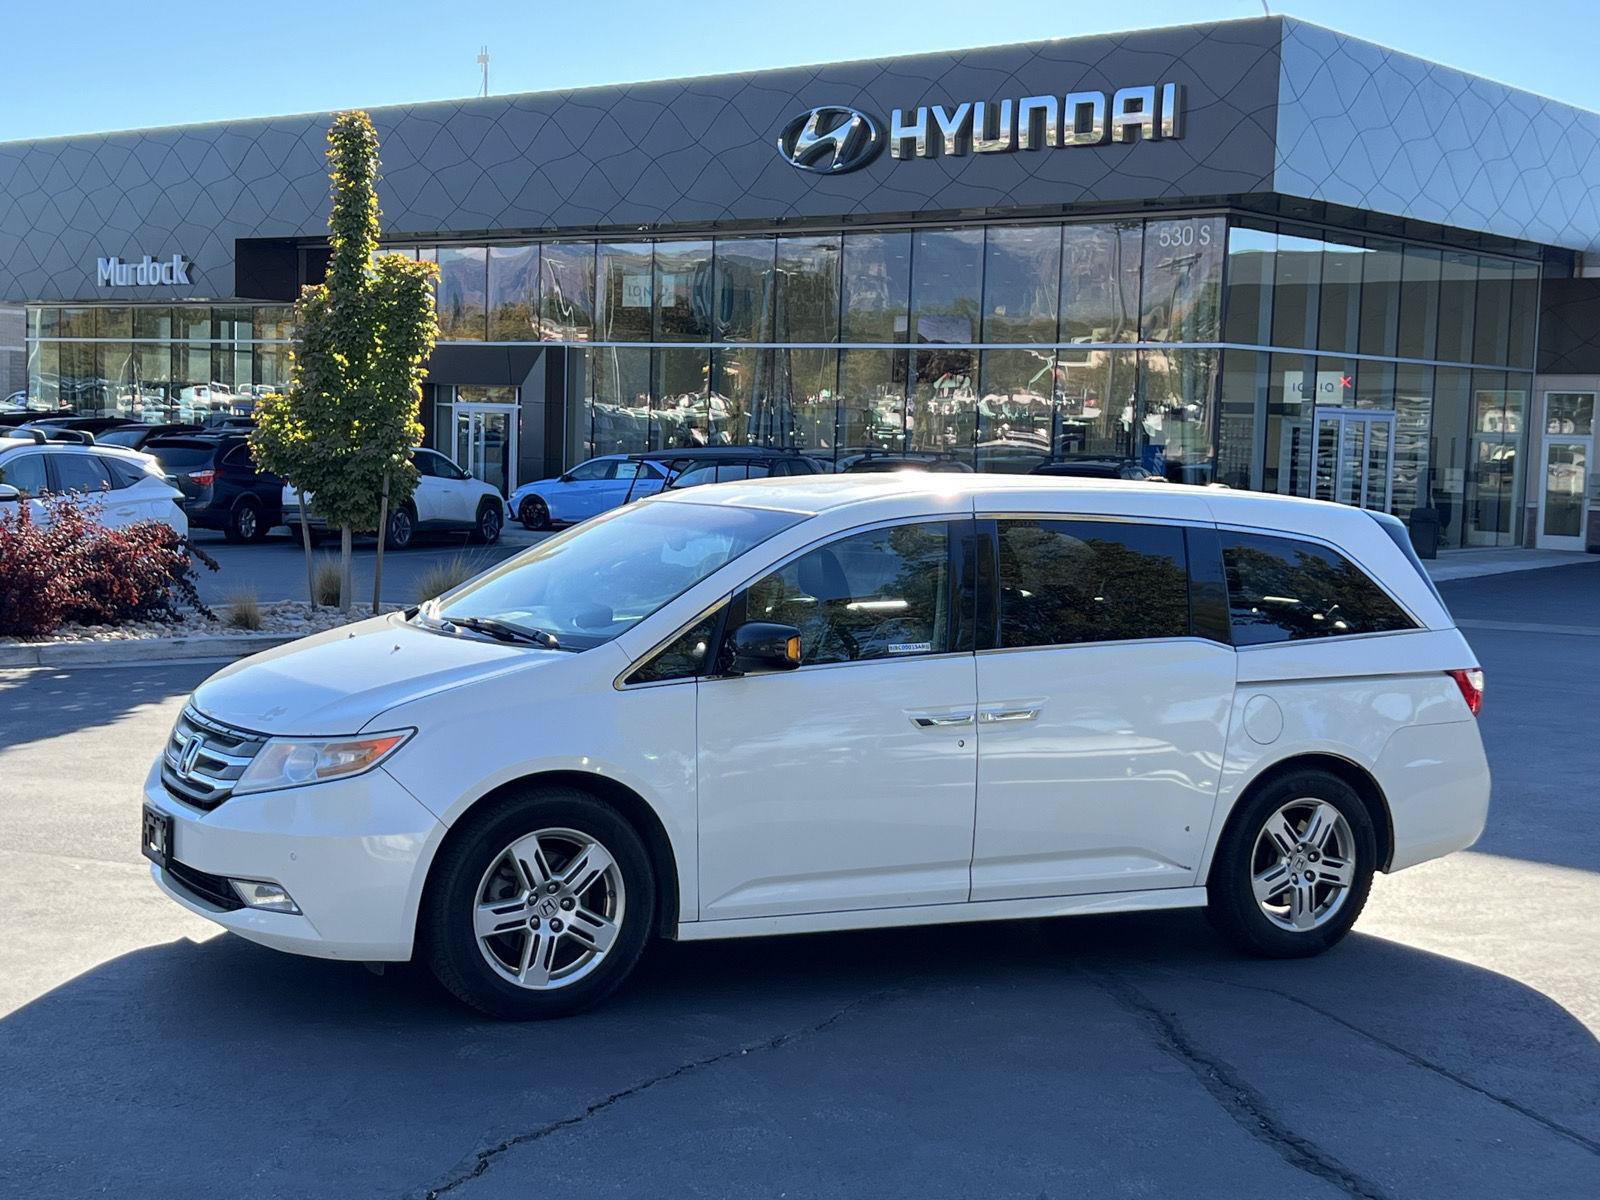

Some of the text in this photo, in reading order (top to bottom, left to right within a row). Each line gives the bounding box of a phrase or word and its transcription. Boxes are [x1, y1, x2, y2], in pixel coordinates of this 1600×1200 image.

[890, 82, 1179, 160] HYUNDAI
[1159, 224, 1211, 247] 530 S
[97, 254, 190, 287] Murdock
